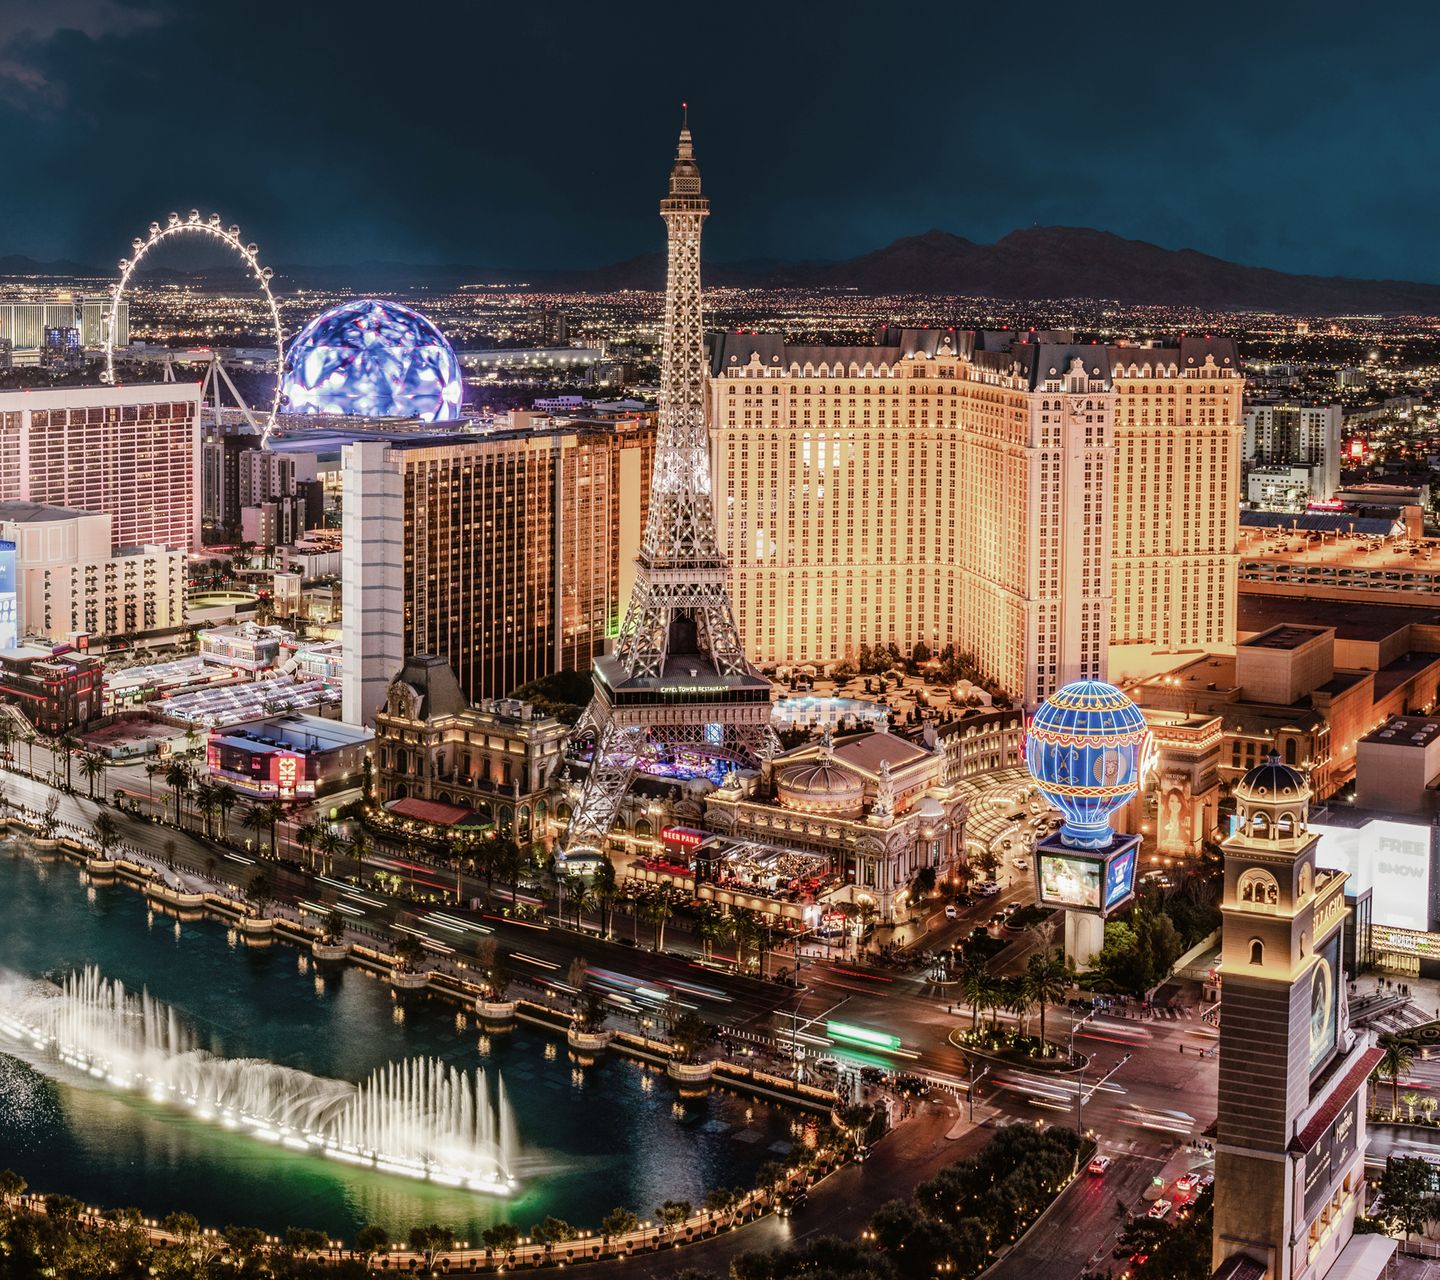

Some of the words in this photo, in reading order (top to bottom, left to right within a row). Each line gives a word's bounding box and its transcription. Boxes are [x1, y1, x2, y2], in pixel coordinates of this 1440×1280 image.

[663, 831, 680, 841] BEER
[681, 834, 700, 845] PARK
[1379, 837, 1426, 856] FREE
[1378, 861, 1425, 878] SHOW
[1313, 893, 1343, 935] LLAGIO
